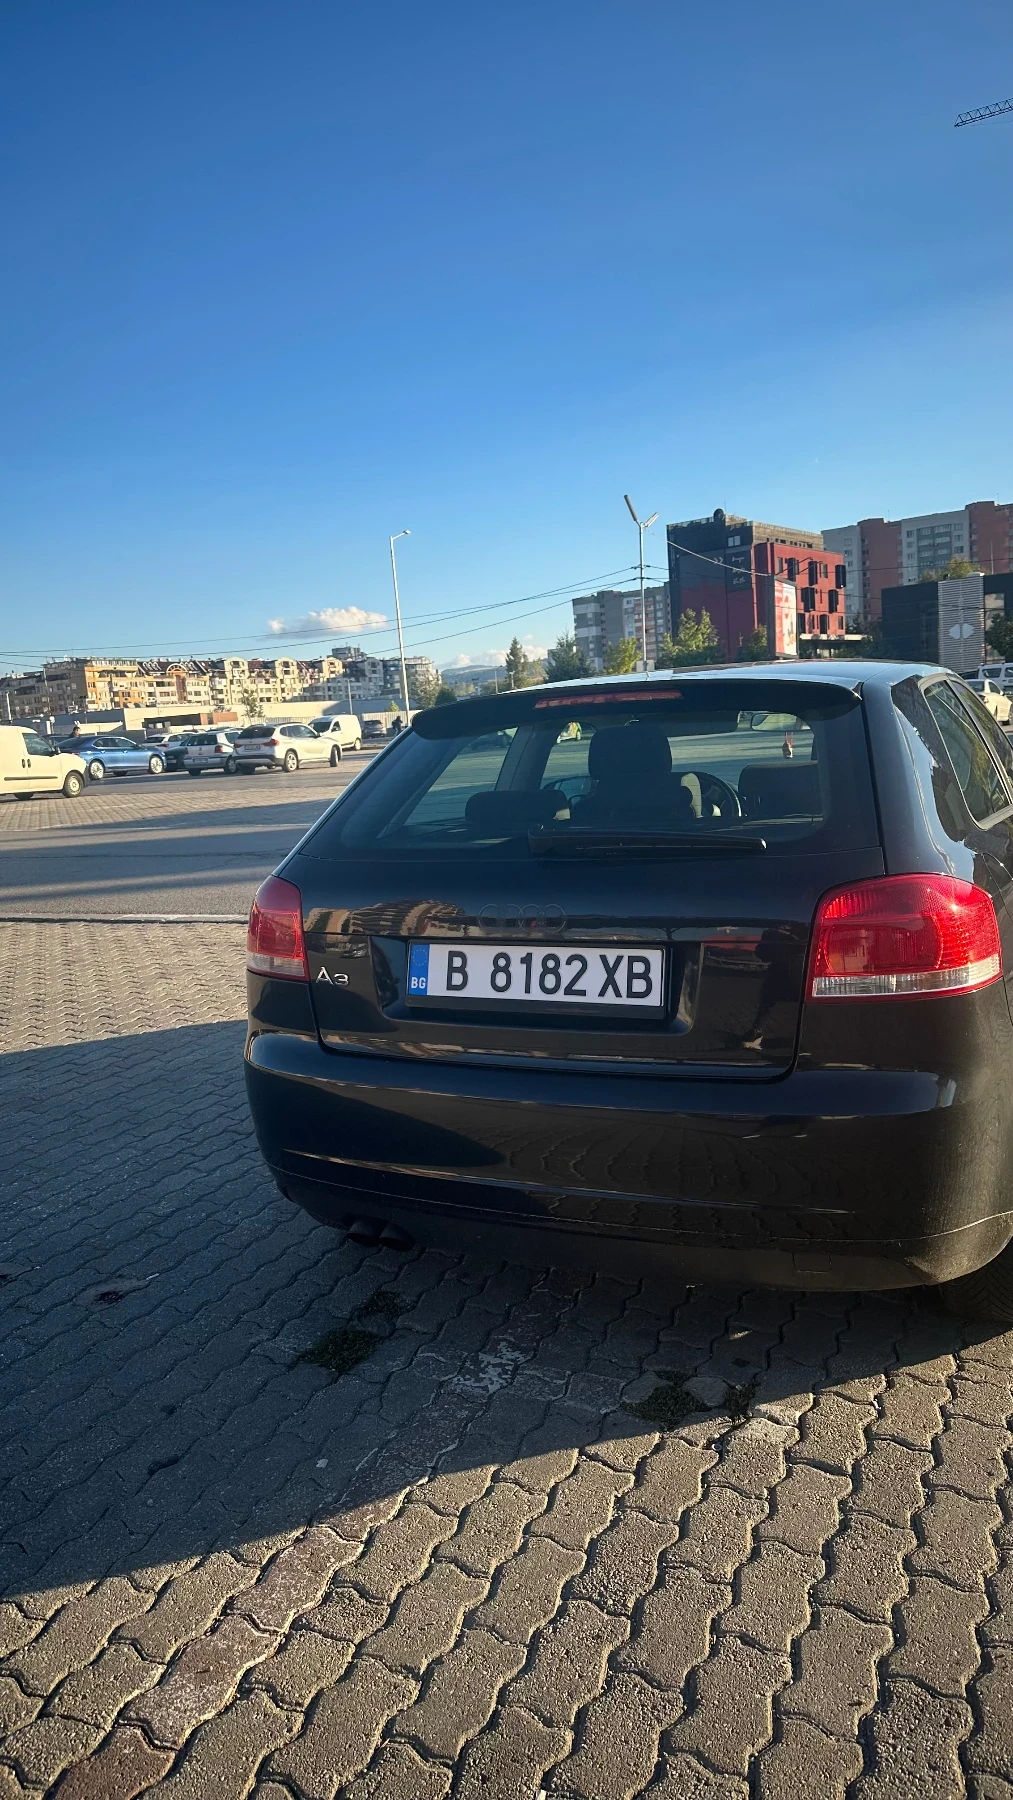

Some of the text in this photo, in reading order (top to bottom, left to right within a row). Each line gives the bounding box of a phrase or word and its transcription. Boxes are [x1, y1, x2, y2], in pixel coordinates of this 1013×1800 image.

[316, 966, 349, 986] A3
[411, 976, 426, 989] BG
[446, 950, 653, 999] B 8182 XB
